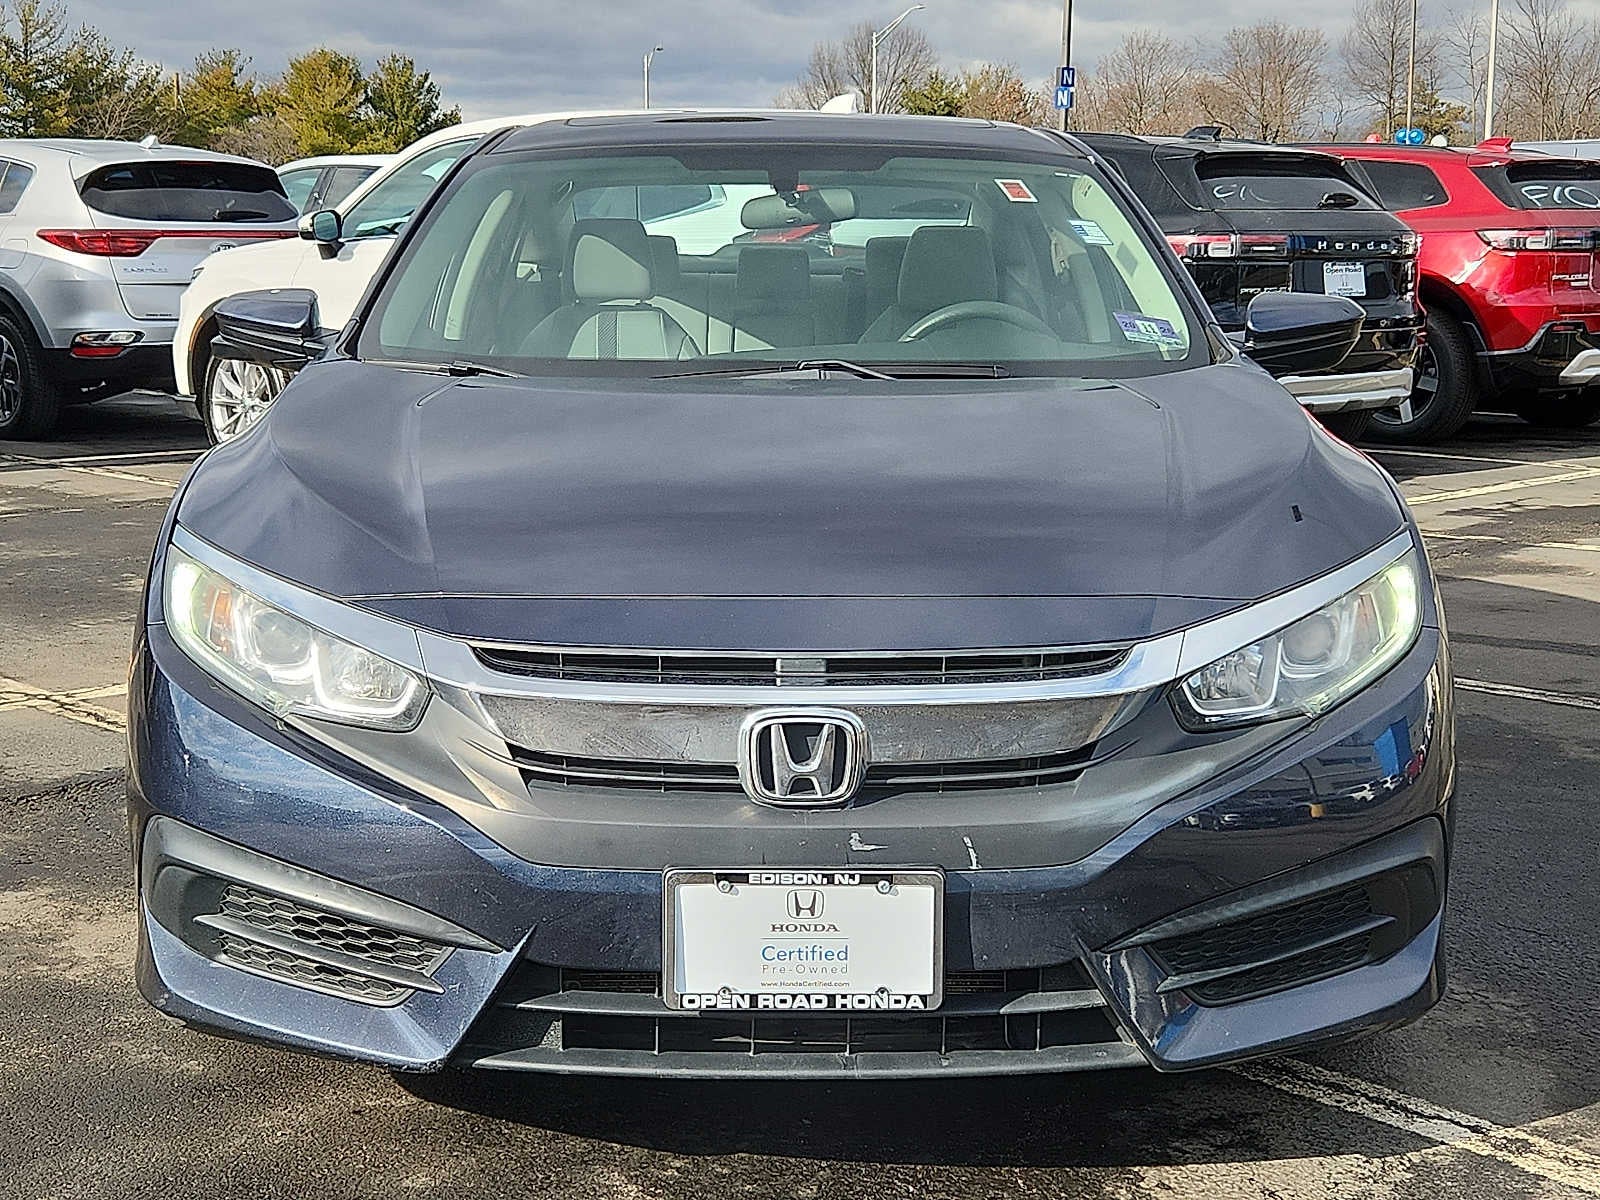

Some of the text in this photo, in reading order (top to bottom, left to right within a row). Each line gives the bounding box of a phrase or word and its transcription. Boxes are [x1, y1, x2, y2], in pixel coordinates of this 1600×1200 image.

[1063, 69, 1074, 85] N
[1057, 90, 1069, 107] N
[1317, 240, 1388, 250] Honda
[1325, 267, 1343, 275] Open
[834, 873, 860, 885] NJ
[771, 923, 841, 933] HONDA
[761, 944, 849, 961] Certified
[762, 963, 848, 974] Pre-Owned
[760, 980, 850, 988] www.HondaCertified.com
[682, 994, 925, 1009] OPEN ROAD HONDA
